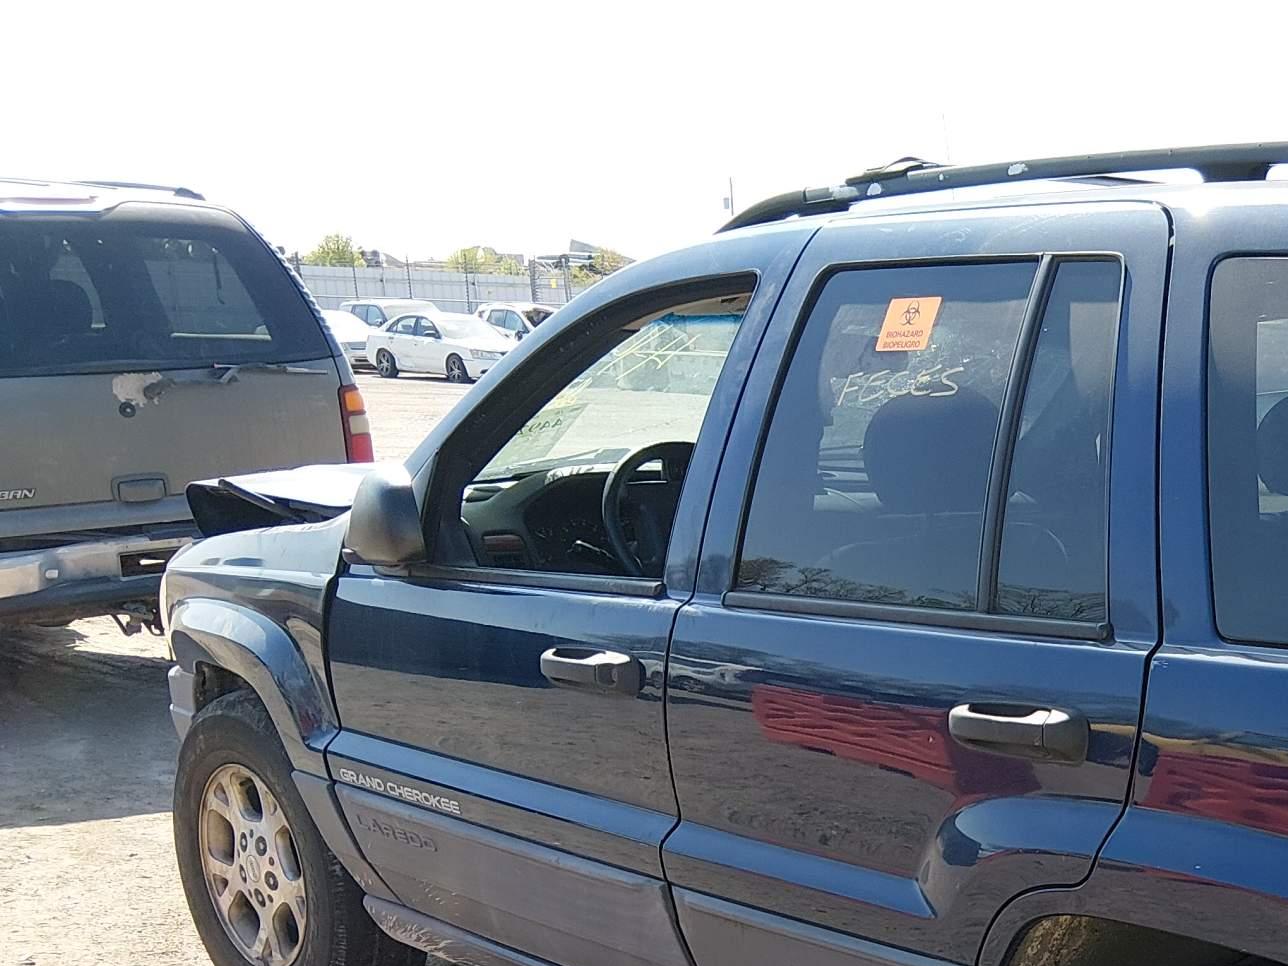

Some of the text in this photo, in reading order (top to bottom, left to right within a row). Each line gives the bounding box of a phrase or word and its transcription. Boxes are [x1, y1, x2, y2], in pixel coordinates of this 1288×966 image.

[886, 330, 924, 338] BIOHAZARD
[838, 364, 964, 406] FECES
[339, 768, 461, 815] GRAND CHEROKEE
[356, 814, 438, 852] LAREDO
